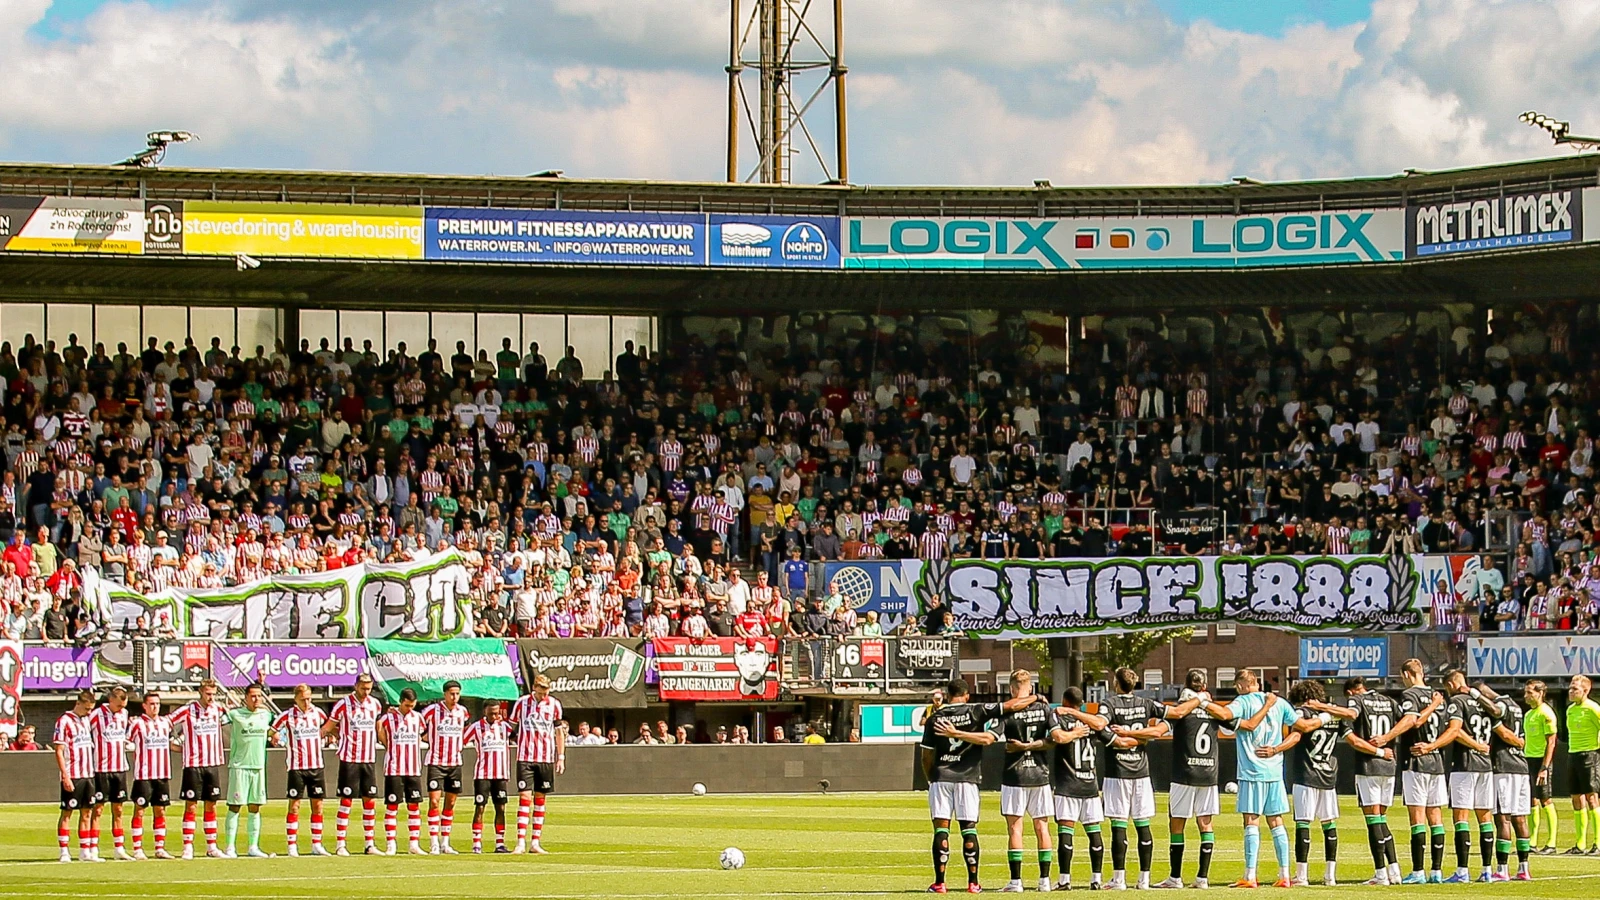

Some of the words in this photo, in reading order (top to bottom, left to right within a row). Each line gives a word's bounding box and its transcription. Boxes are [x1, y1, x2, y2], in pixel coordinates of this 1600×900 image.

[52, 208, 113, 219] Advocatuur
[115, 211, 129, 220] op
[144, 212, 182, 234] rhb
[1416, 191, 1572, 245] METALIMEX
[50, 220, 65, 230] z'n
[67, 221, 132, 232] Rotterdams!
[185, 218, 290, 239] stevedoring
[292, 219, 305, 236] &
[310, 221, 421, 244] warehousing
[437, 219, 514, 236] PREMIUM
[517, 220, 694, 240] FITNESSAPPARATUUR
[145, 241, 180, 249] ROTTERDAM
[438, 238, 544, 254] WATERROWER.NL
[553, 241, 694, 256] INFO@WATERROWER.NL
[849, 219, 1074, 268] LOGIX
[1192, 212, 1386, 262] LOGIX
[1434, 235, 1554, 252] METAALHANDEL
[722, 244, 771, 257] WaterRower
[949, 564, 1197, 620] SINCE
[880, 602, 906, 610] SHIP
[1021, 615, 1105, 630] Schietbaan
[1340, 612, 1366, 625] Het
[149, 645, 182, 674] 15
[530, 650, 621, 672] Spangenaren
[674, 645, 687, 655] BY
[689, 645, 722, 656] ORDER
[836, 644, 860, 665] 16
[1307, 640, 1382, 669] bictgroep
[257, 653, 281, 675] de
[285, 653, 358, 675] Goudse
[683, 661, 694, 672] OF
[696, 662, 716, 672] THE
[842, 667, 852, 677] A
[548, 674, 612, 692] otterdam
[662, 678, 736, 691] SPANGENAREN
[1369, 715, 1390, 738] 10
[1470, 715, 1492, 746] 33
[1195, 722, 1210, 754] 6
[1309, 730, 1338, 761] 24
[1074, 738, 1095, 769] 14
